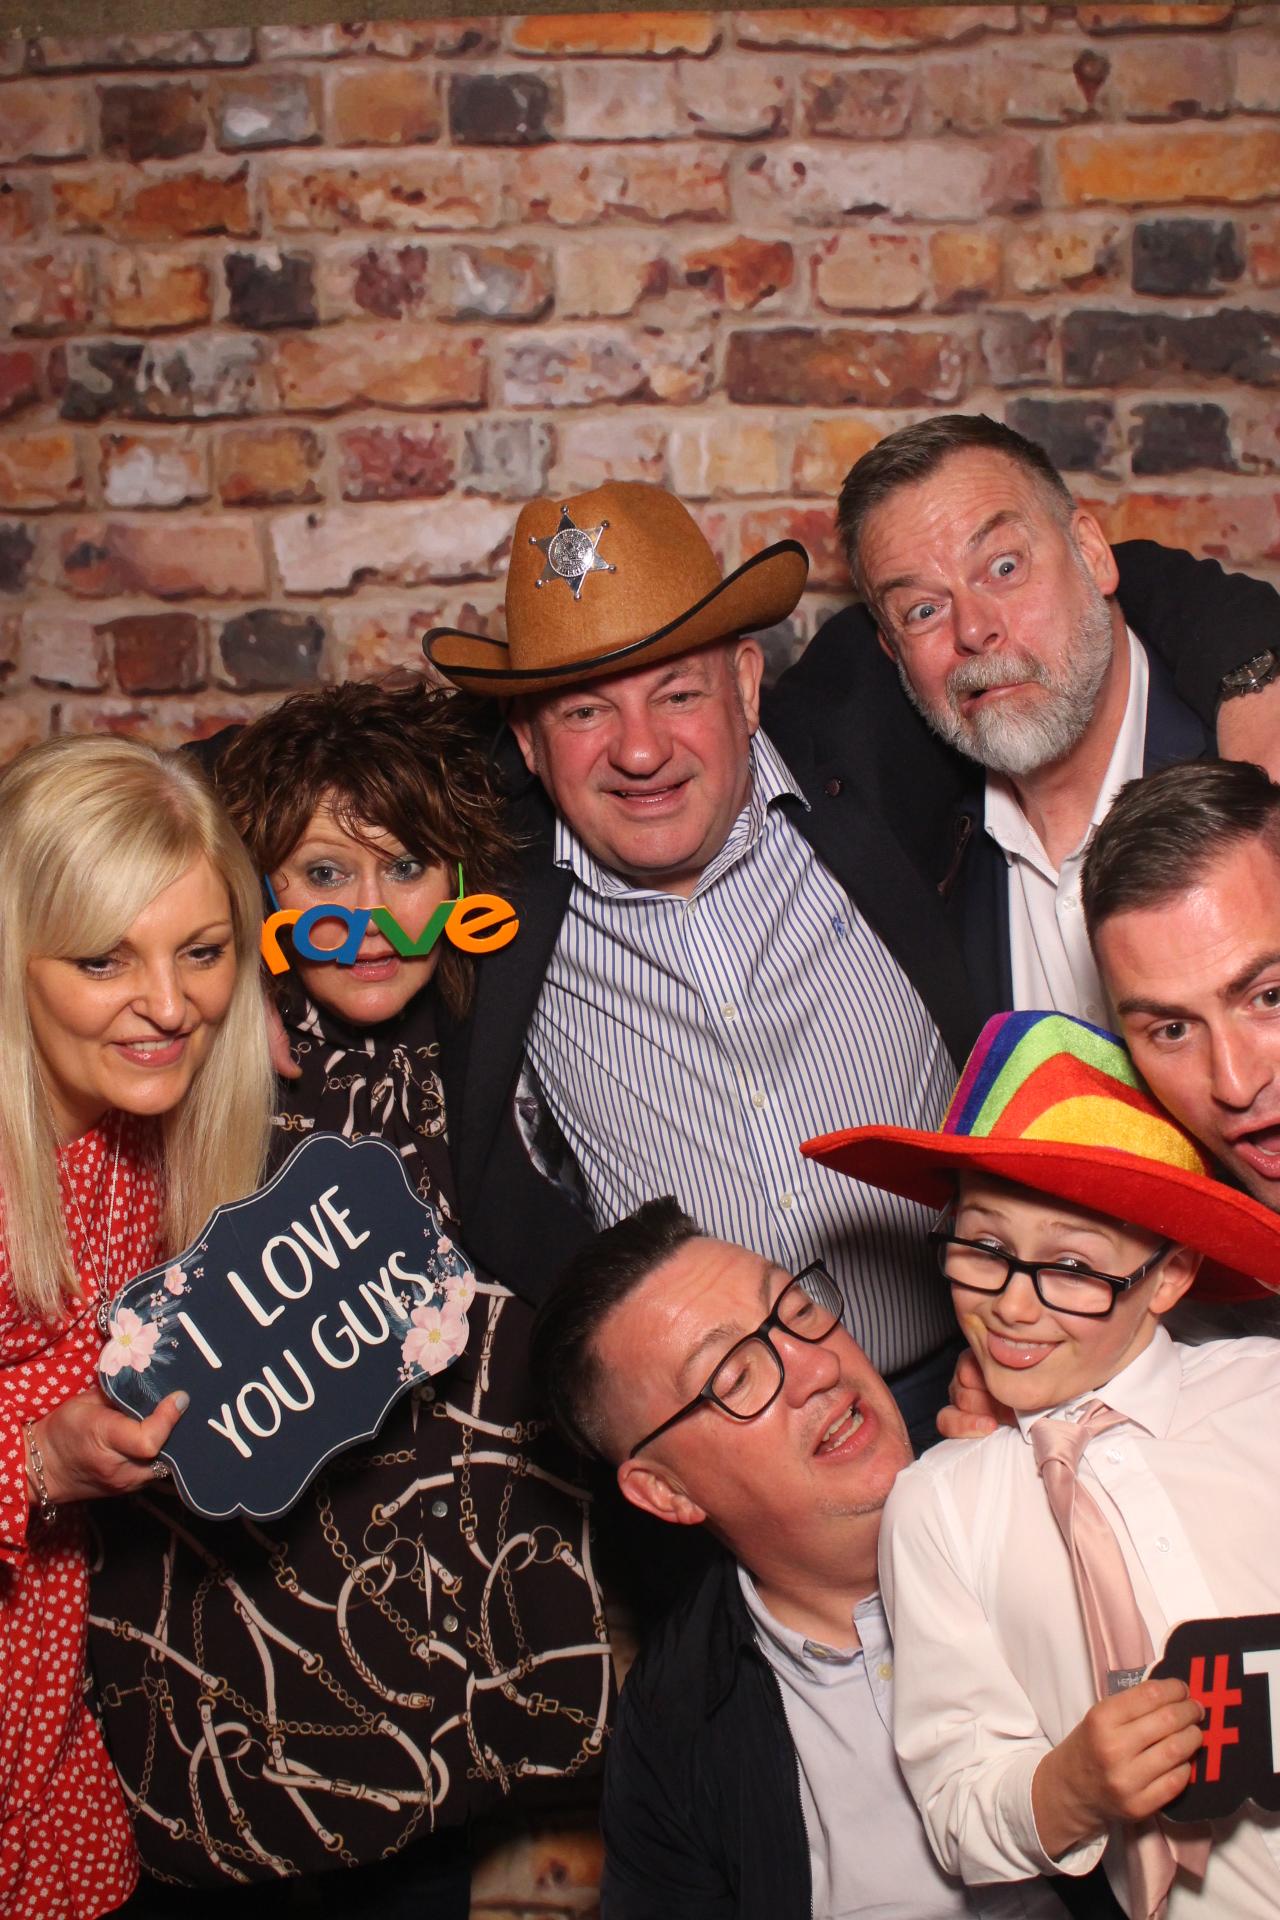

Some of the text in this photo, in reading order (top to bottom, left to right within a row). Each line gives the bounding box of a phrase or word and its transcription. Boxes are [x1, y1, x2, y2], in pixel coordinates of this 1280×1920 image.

[259, 893, 520, 976] rave
[177, 1185, 371, 1369] I LOVE
[207, 1251, 435, 1458] YOU GUYS
